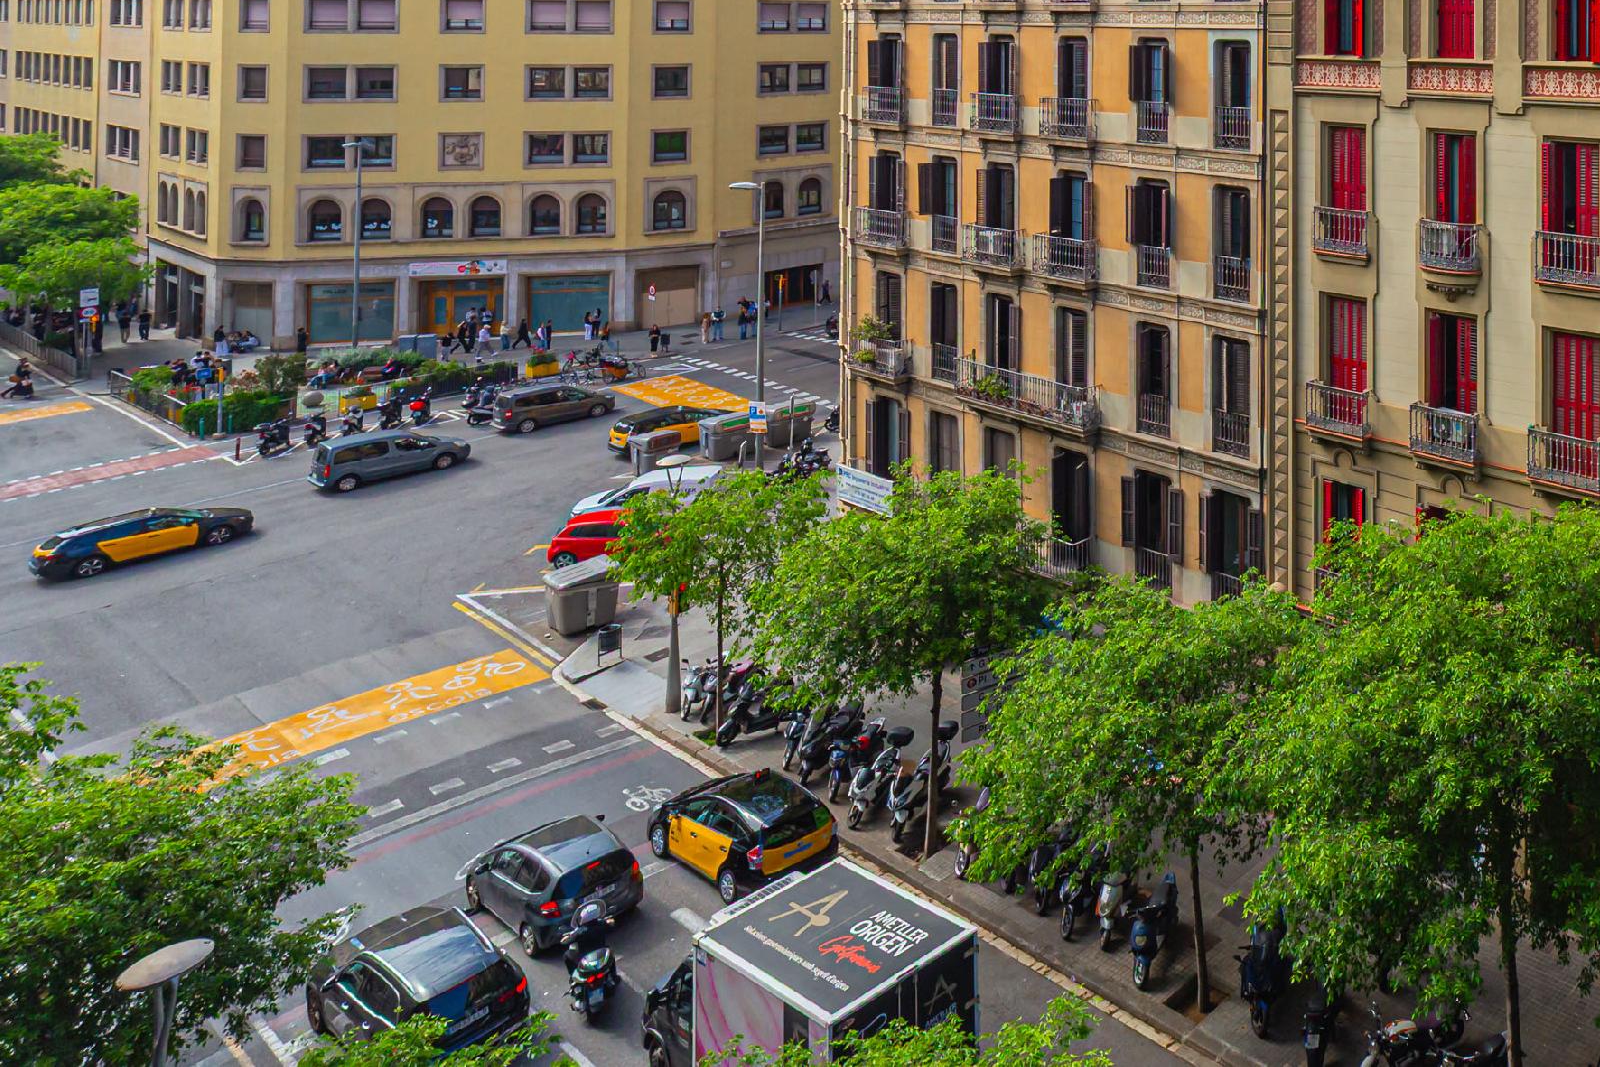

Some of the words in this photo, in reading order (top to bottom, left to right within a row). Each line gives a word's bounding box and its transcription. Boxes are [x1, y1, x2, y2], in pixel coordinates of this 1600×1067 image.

[387, 688, 493, 724] escola
[849, 919, 915, 957] ORIGEN
[868, 910, 930, 945] AMETLLER
